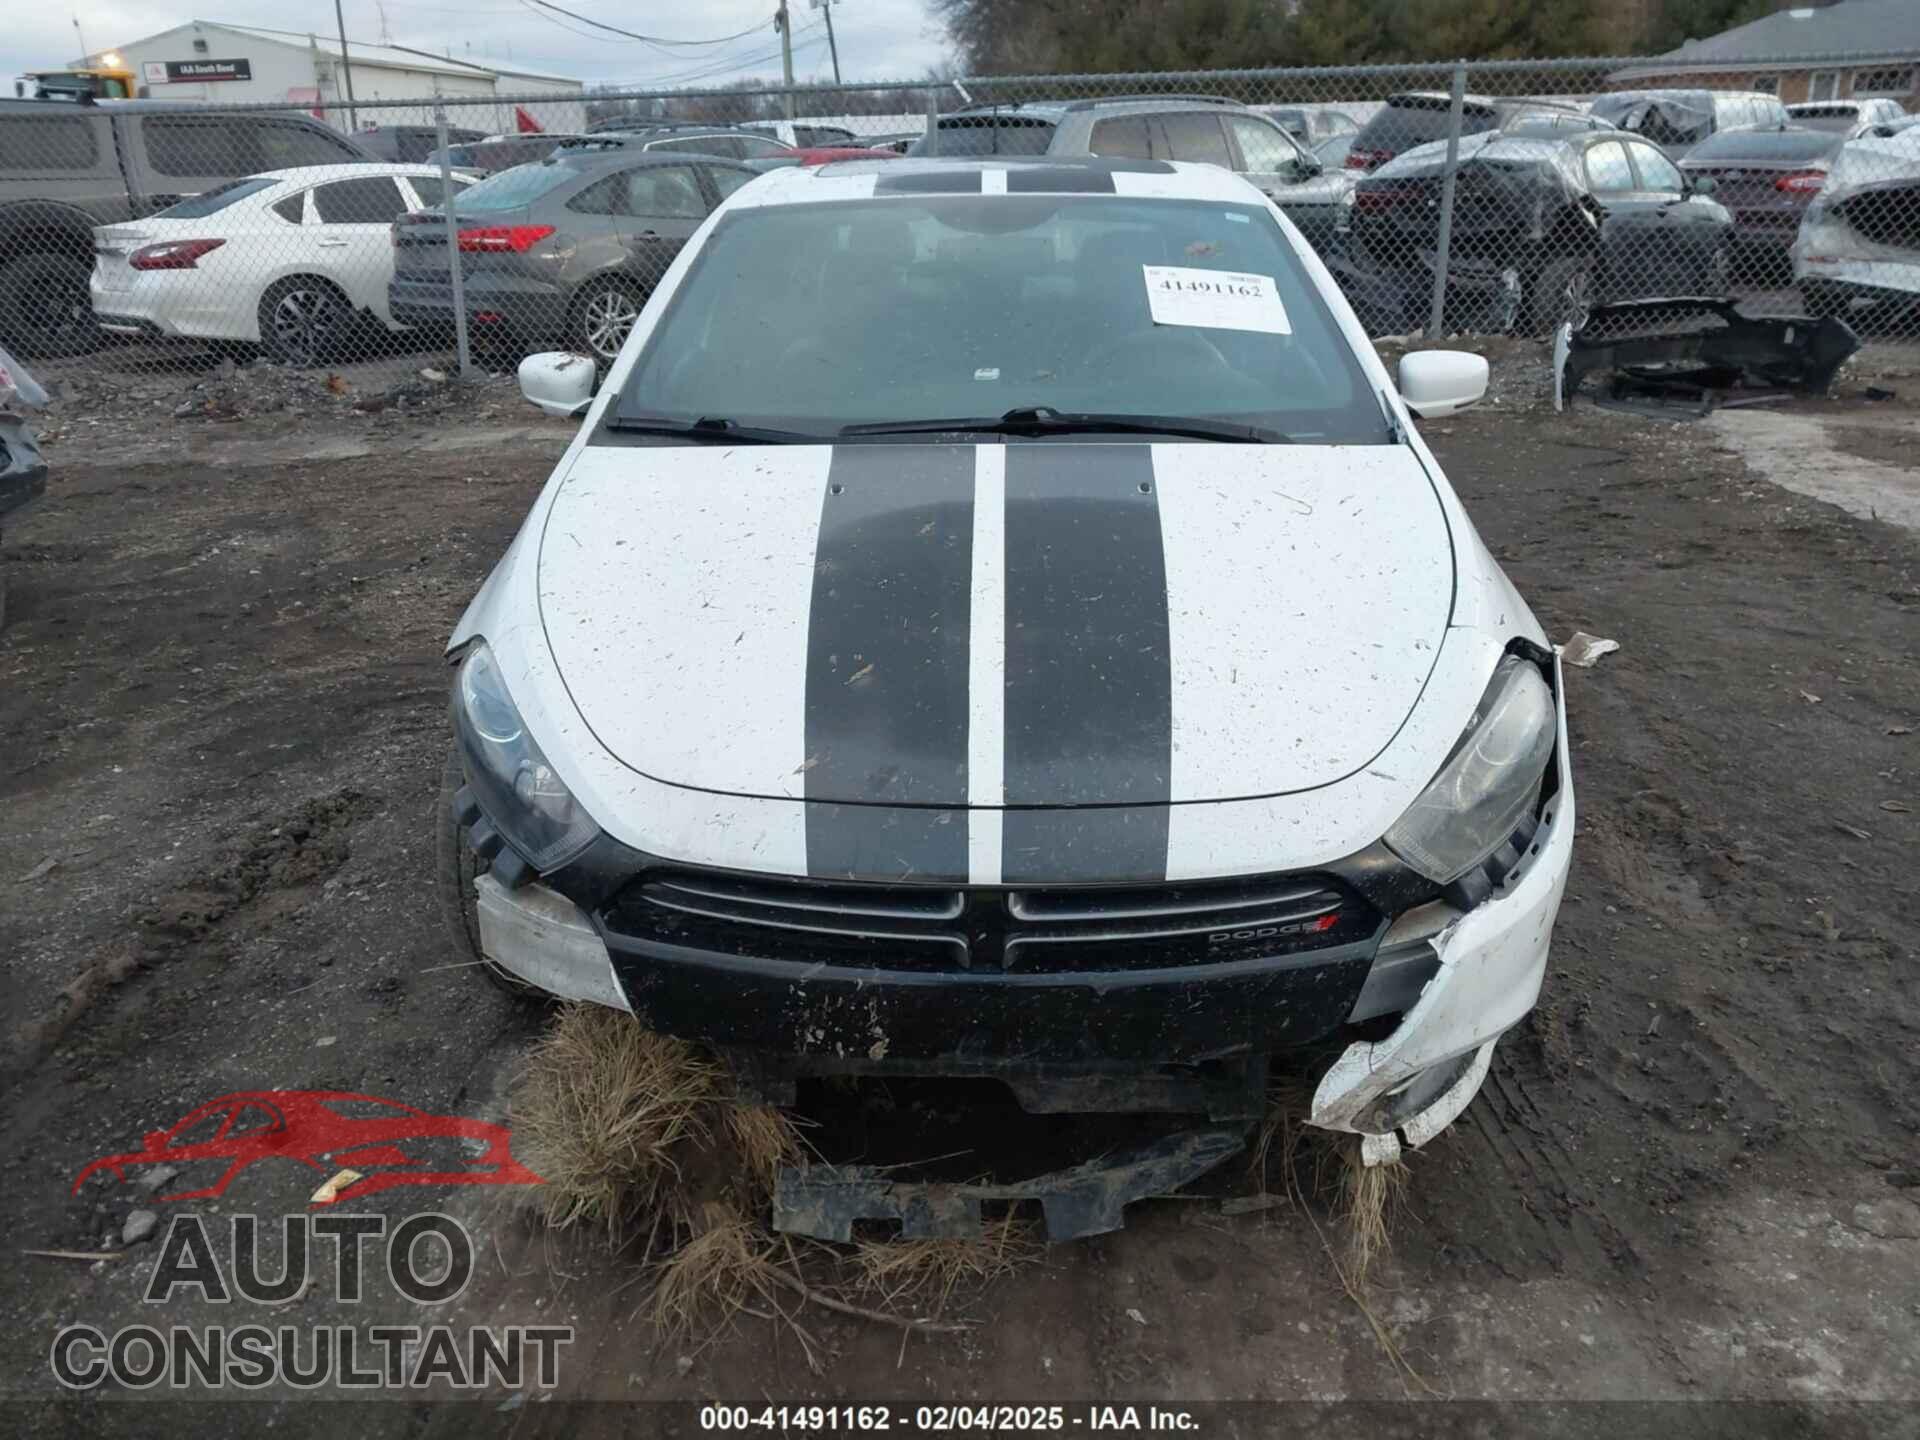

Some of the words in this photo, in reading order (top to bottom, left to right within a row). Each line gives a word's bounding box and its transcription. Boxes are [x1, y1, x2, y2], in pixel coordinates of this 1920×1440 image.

[180, 65, 194, 74] IAA
[1160, 279, 1263, 297] 41491162
[1208, 921, 1319, 943] DODGE
